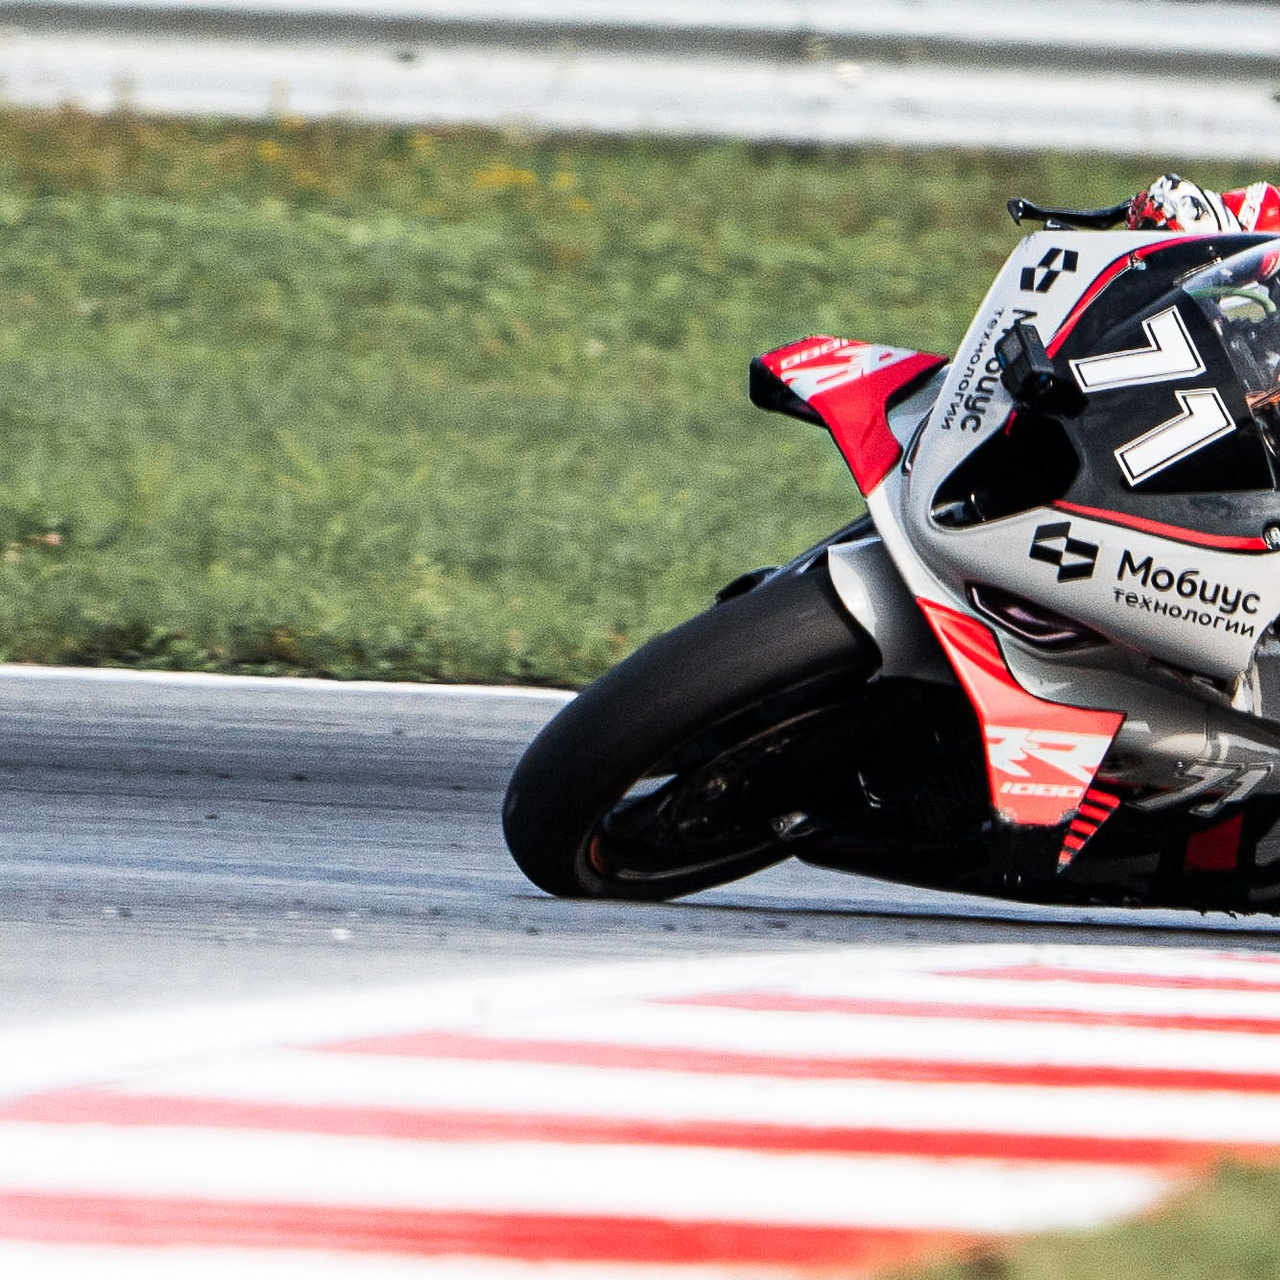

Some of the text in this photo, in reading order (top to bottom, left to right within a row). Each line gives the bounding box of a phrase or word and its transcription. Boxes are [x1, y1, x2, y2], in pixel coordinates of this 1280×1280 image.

[1068, 305, 1237, 487] 71
[1112, 587, 1256, 638] технологии
[1116, 549, 1261, 615] Мобиус
